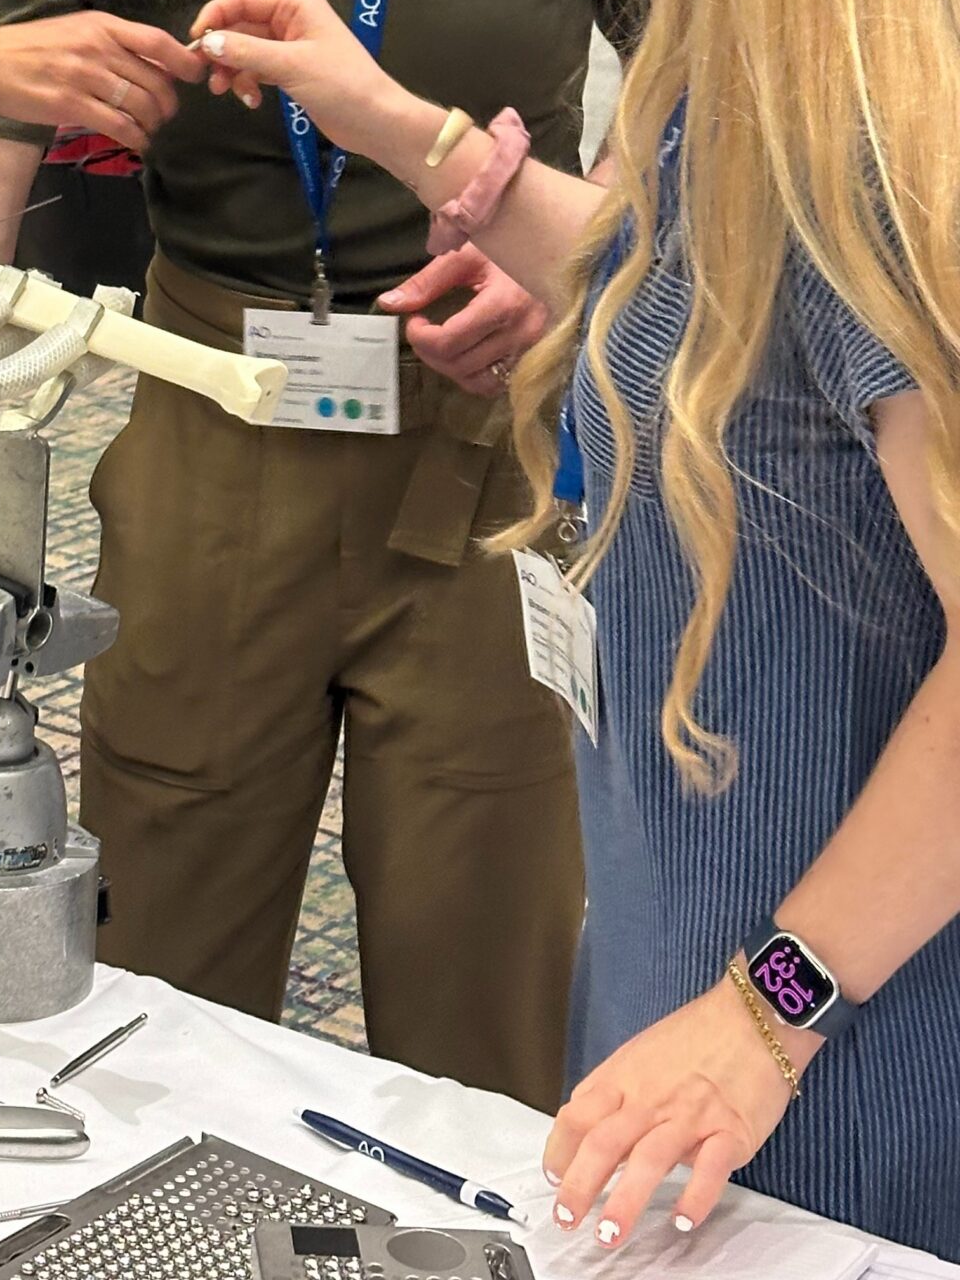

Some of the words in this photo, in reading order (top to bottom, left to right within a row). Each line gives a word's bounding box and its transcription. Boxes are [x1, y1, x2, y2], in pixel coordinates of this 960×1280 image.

[287, 101, 310, 135] AO
[778, 979, 814, 1014] 10
[358, 1140, 385, 1163] AO
